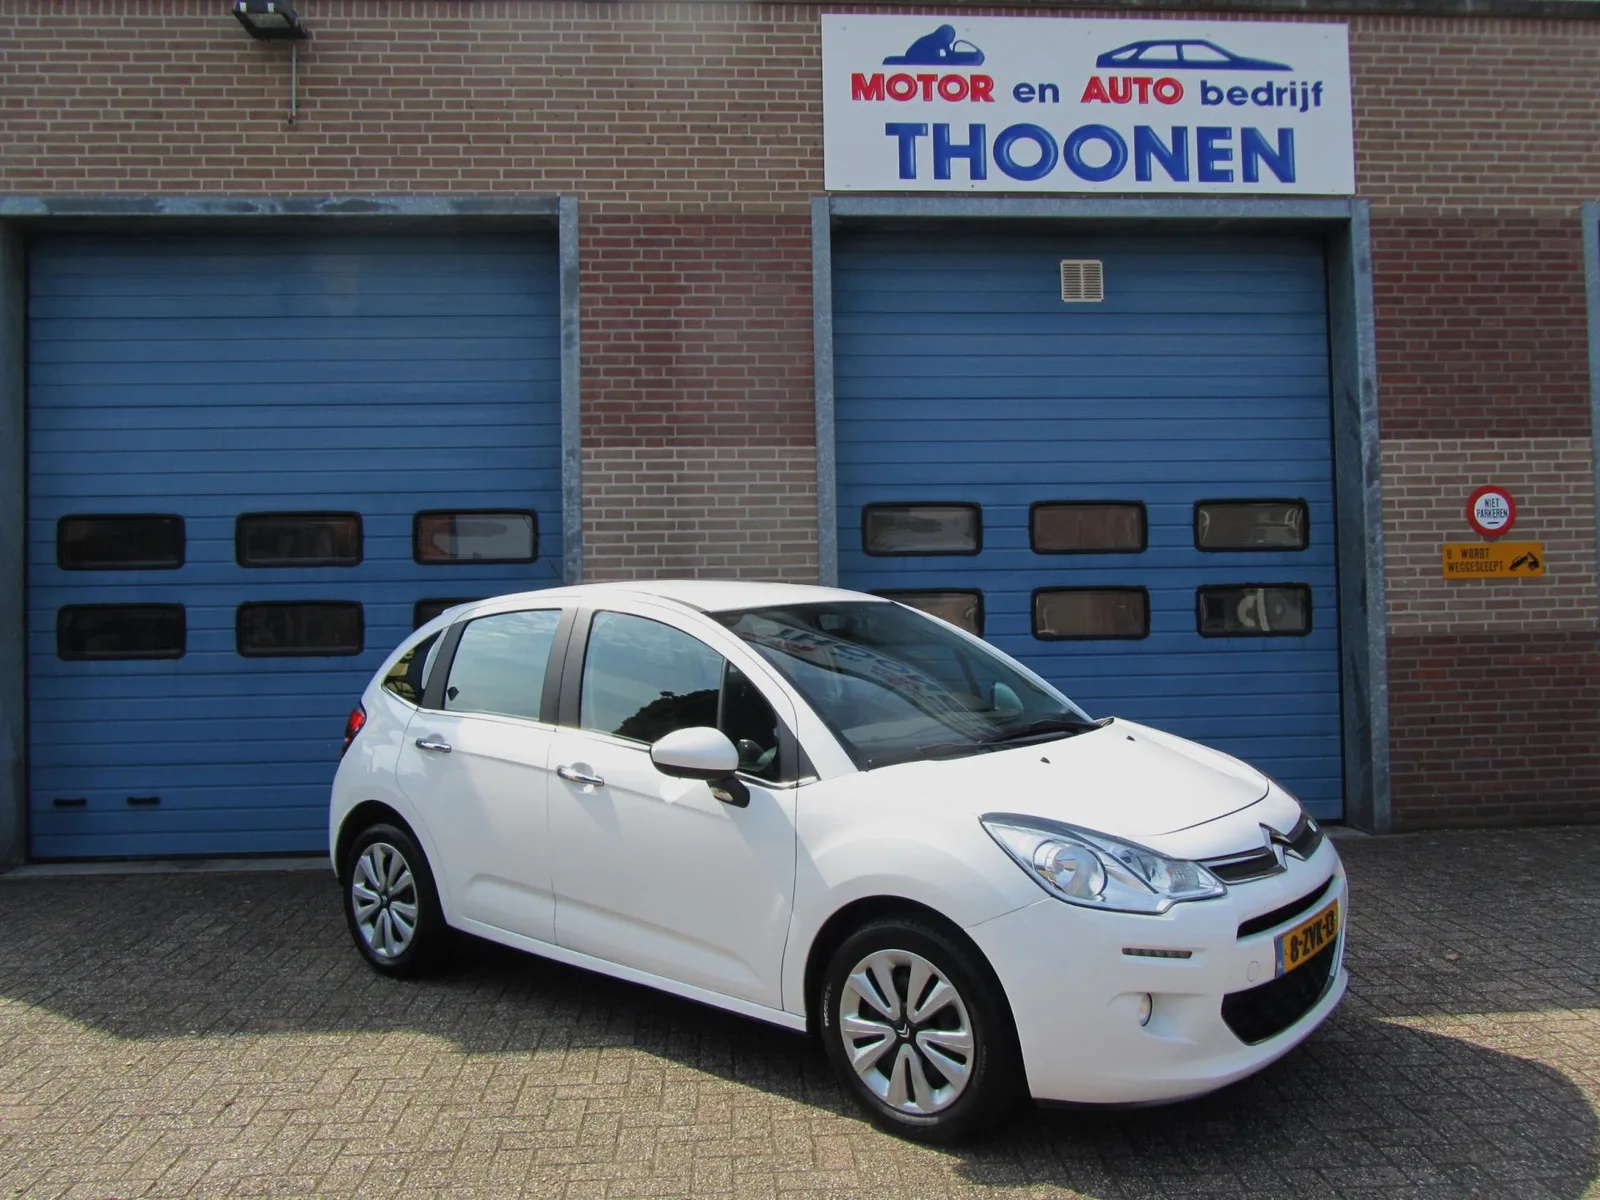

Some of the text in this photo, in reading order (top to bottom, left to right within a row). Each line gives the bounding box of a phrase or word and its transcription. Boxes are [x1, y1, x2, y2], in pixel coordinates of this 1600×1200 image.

[850, 72, 1323, 112] MOTOR en AUTO bedrijf
[885, 122, 1296, 183] THOONEN
[1484, 498, 1500, 508] NIET
[1476, 508, 1508, 519] PARKEREN
[1446, 547, 1490, 559] U WORDT
[1446, 560, 1504, 573] WEGGESLEEPT
